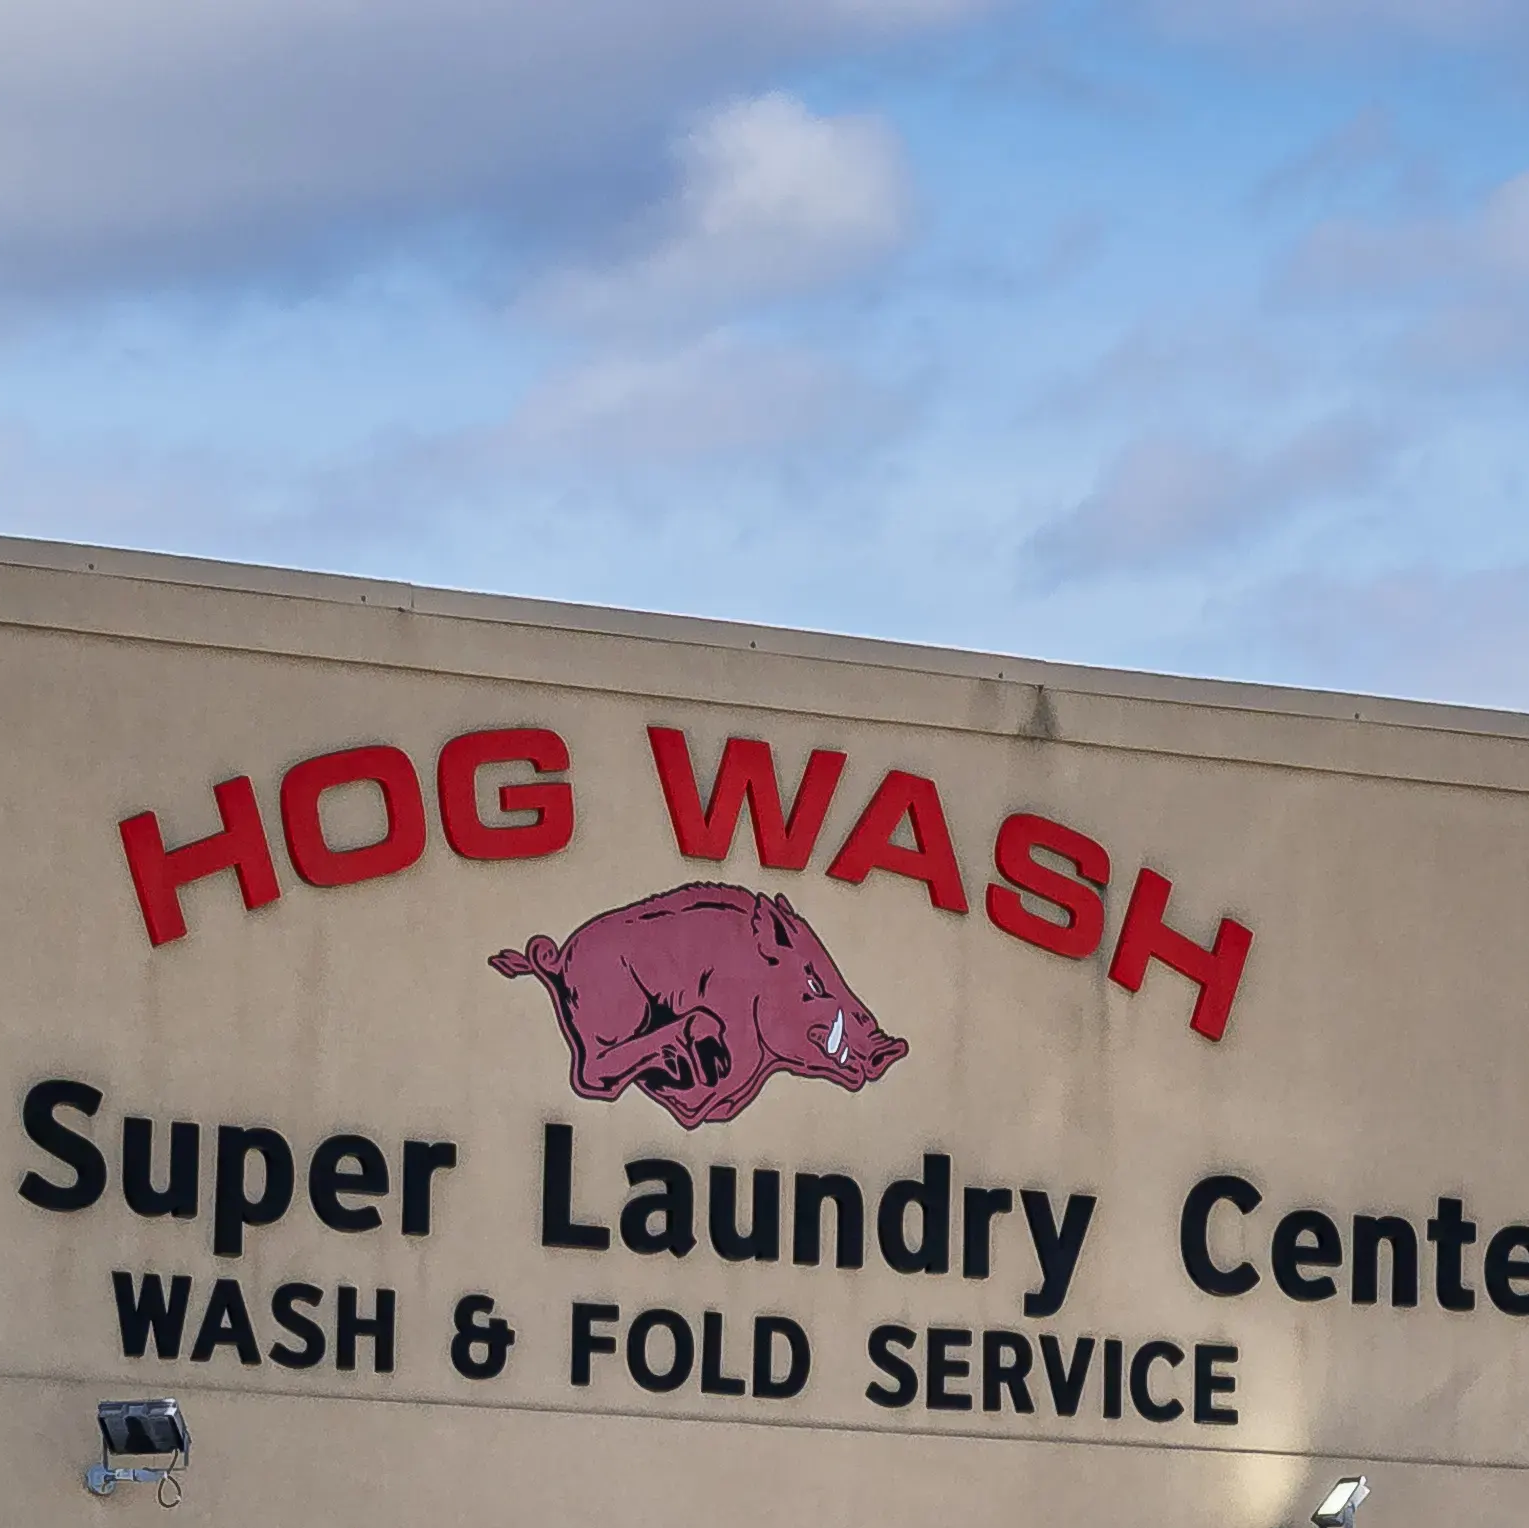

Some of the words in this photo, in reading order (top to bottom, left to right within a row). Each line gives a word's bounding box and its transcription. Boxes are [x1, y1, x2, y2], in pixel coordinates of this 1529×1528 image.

[118, 727, 575, 948] HOG
[646, 726, 1254, 1042] WASH
[17, 1079, 456, 1257] Super
[541, 1122, 1097, 1318] Laundry
[111, 1270, 396, 1374] WASH
[451, 1294, 516, 1380] &
[570, 1302, 811, 1399] FOLD
[865, 1324, 1240, 1425] SERVICE
